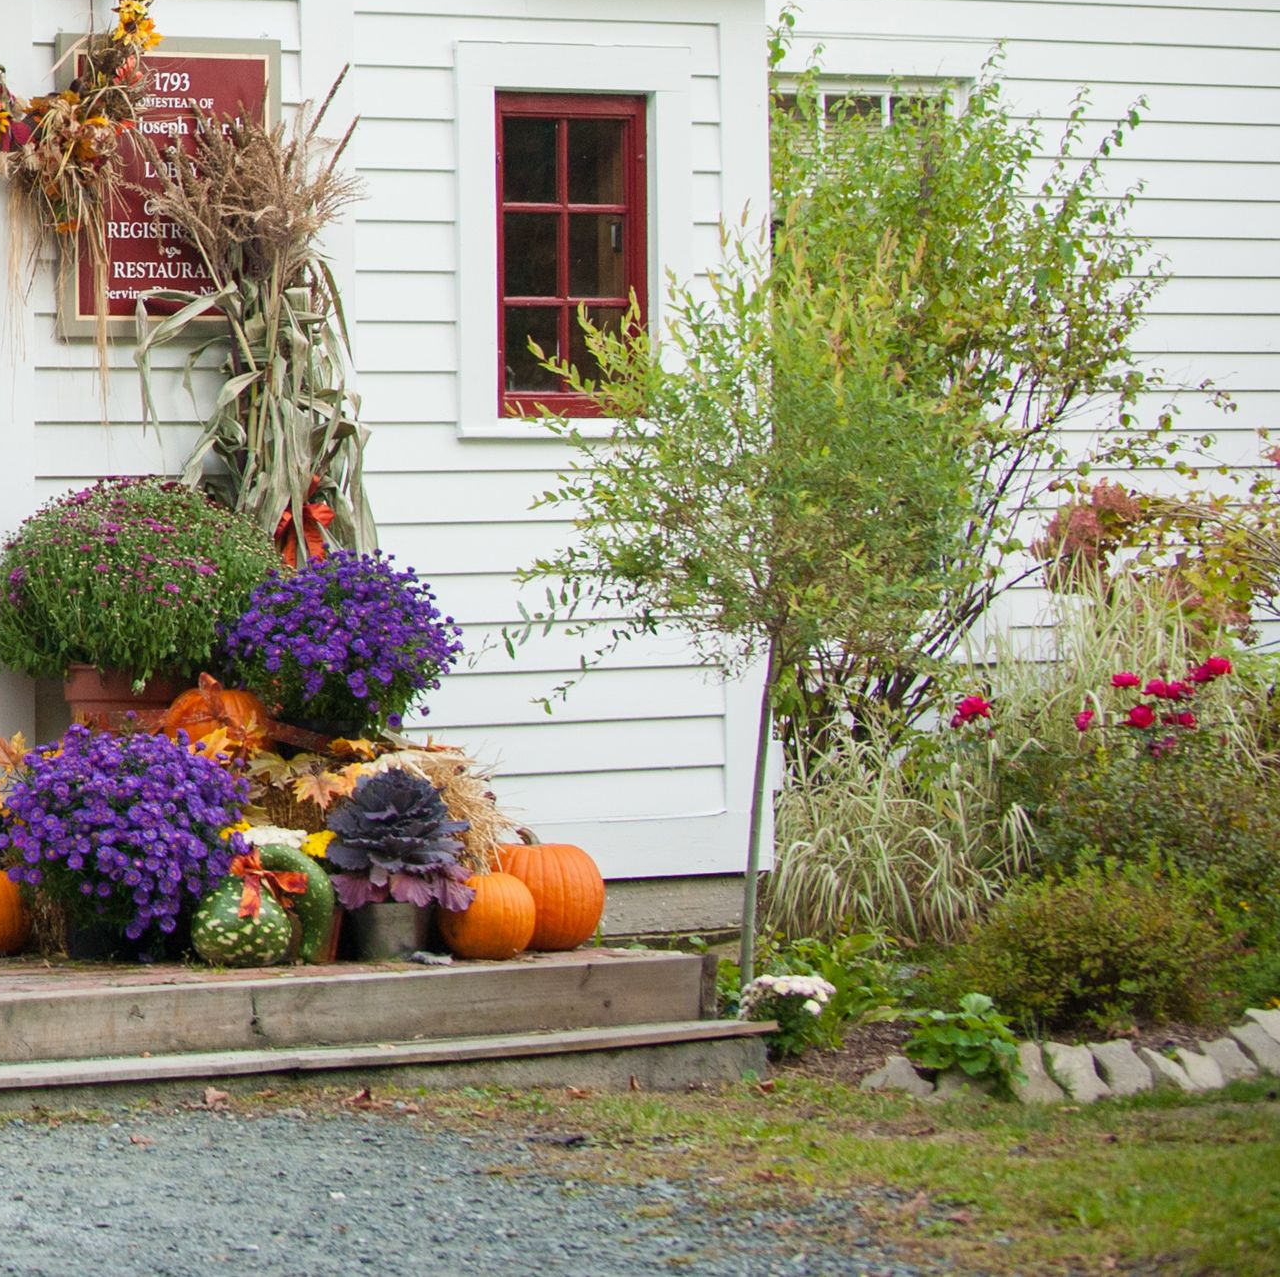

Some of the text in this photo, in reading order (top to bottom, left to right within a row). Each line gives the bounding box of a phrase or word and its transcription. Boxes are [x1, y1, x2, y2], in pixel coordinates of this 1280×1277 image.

[154, 72, 190, 92] 1793
[199, 98, 214, 109] OF
[138, 116, 189, 138] Joseph
[113, 261, 212, 279] RESTAURA
